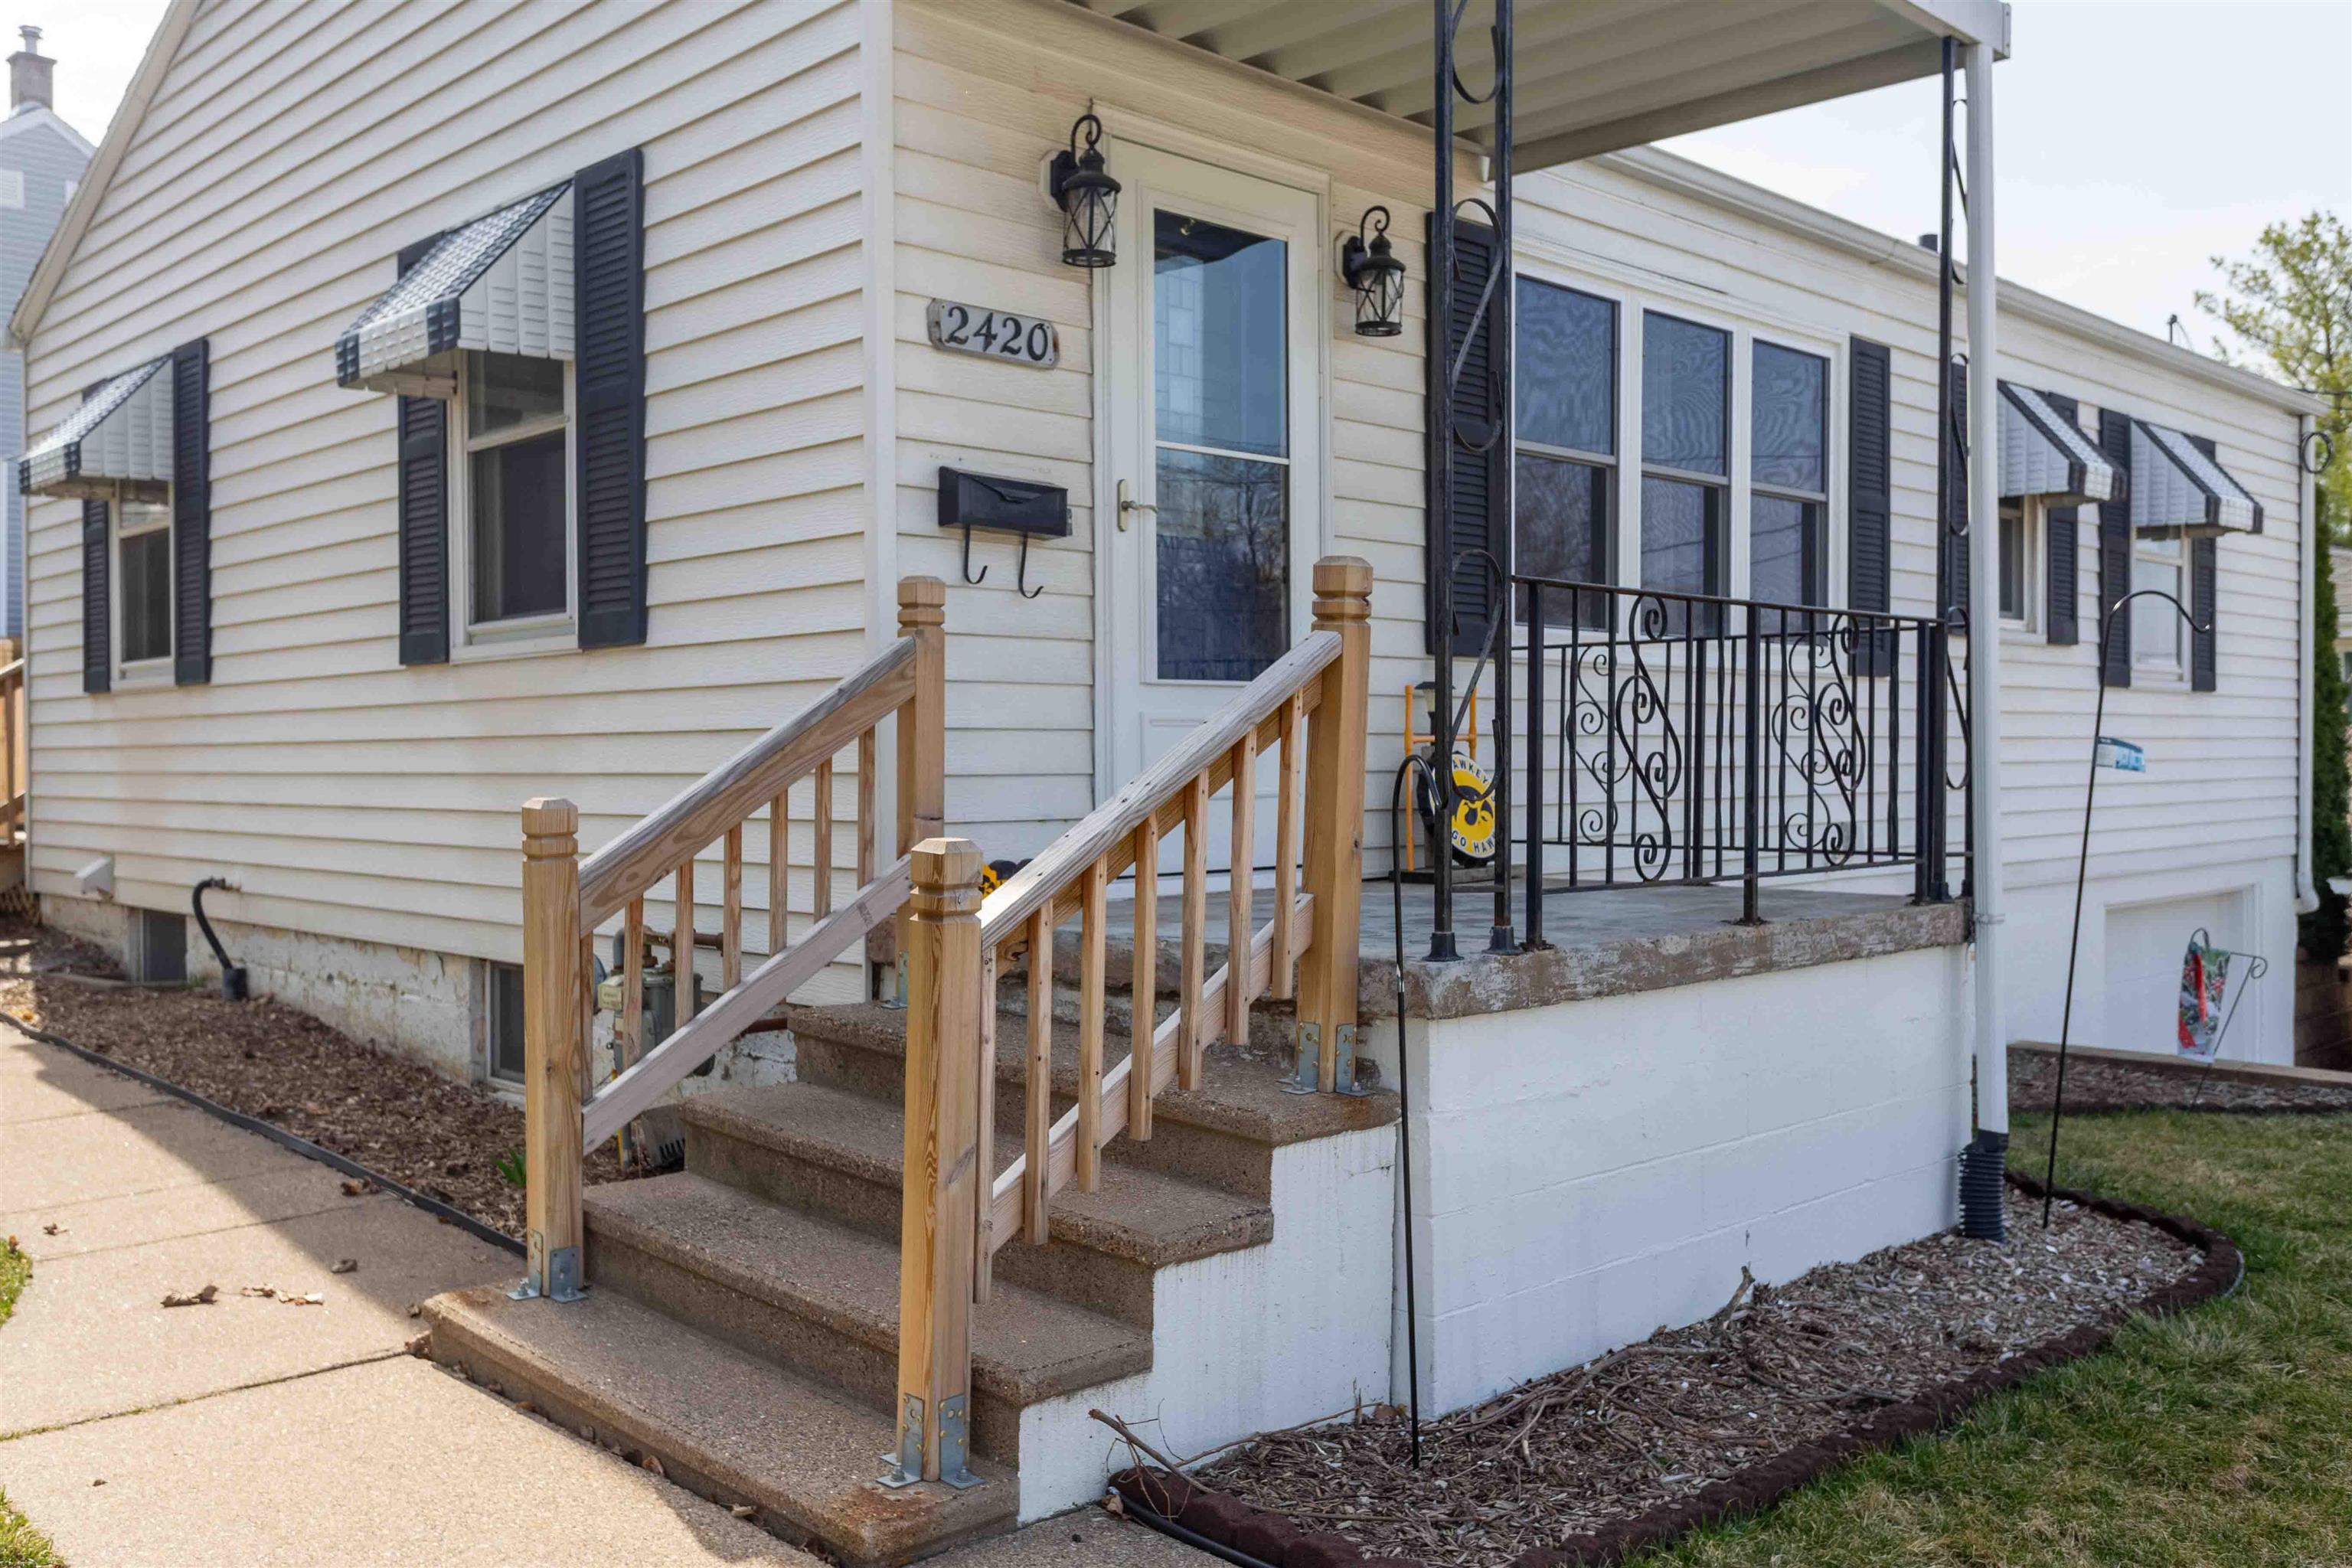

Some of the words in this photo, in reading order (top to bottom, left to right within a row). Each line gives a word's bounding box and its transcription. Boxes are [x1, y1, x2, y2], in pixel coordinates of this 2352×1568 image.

[944, 305, 1048, 361] 2420
[1452, 830, 1467, 847] GO
[1474, 831, 1495, 853] HAW
